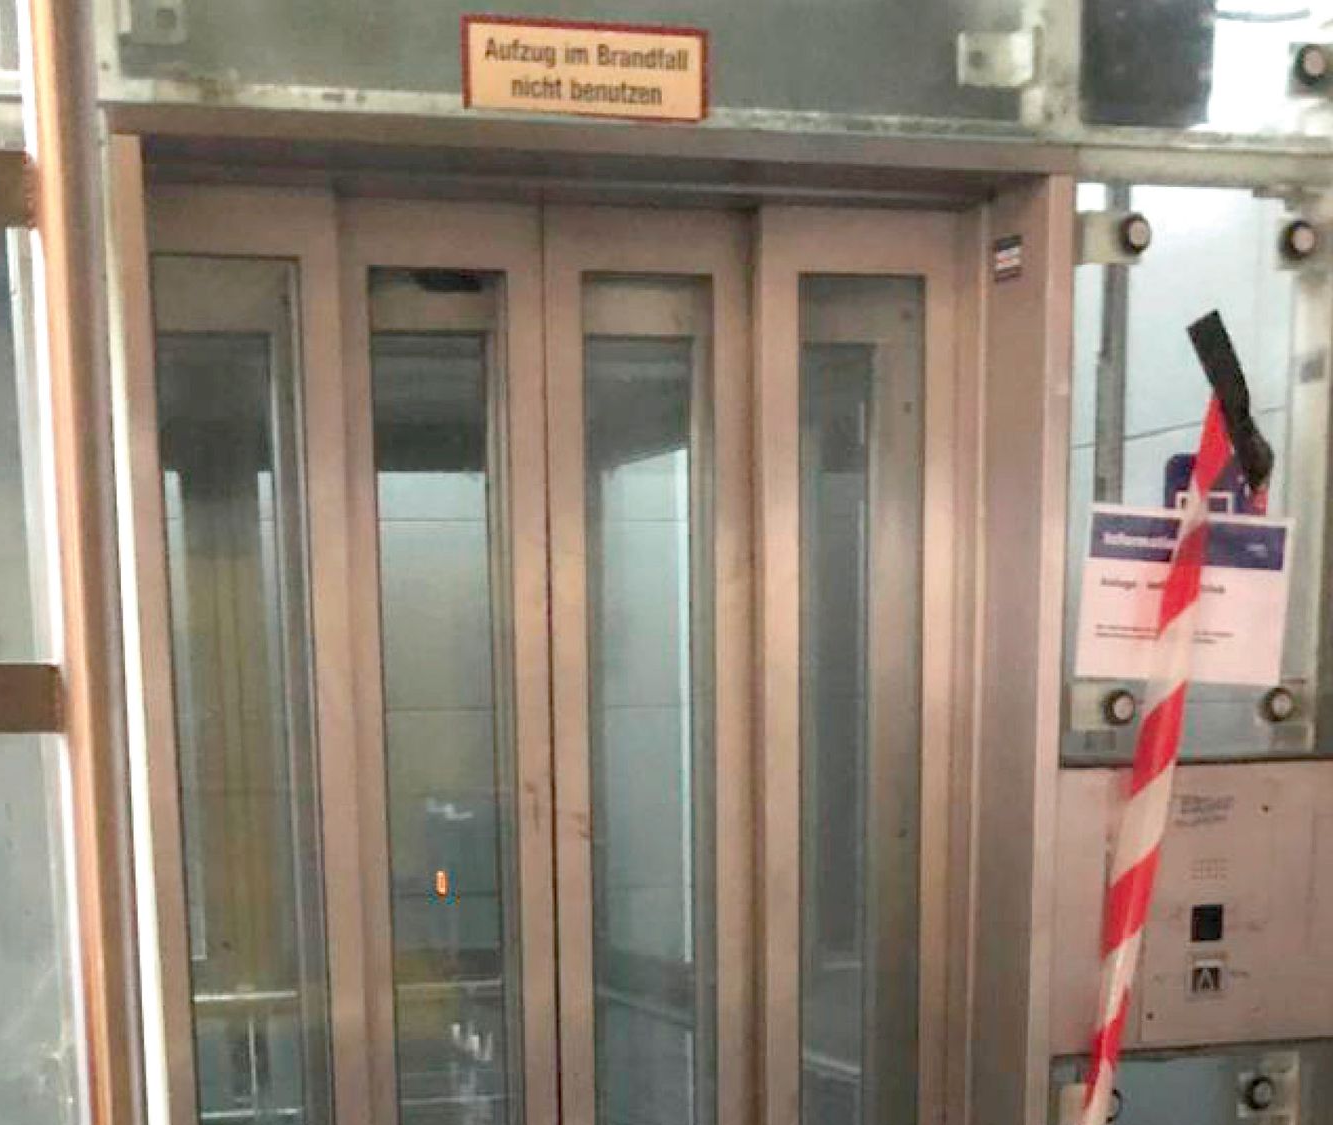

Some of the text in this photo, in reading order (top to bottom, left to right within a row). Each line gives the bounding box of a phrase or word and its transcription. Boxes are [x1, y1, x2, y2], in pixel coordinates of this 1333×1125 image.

[485, 37, 689, 72] Aufzug im Brandfall
[511, 76, 663, 105] nicht benutzen
